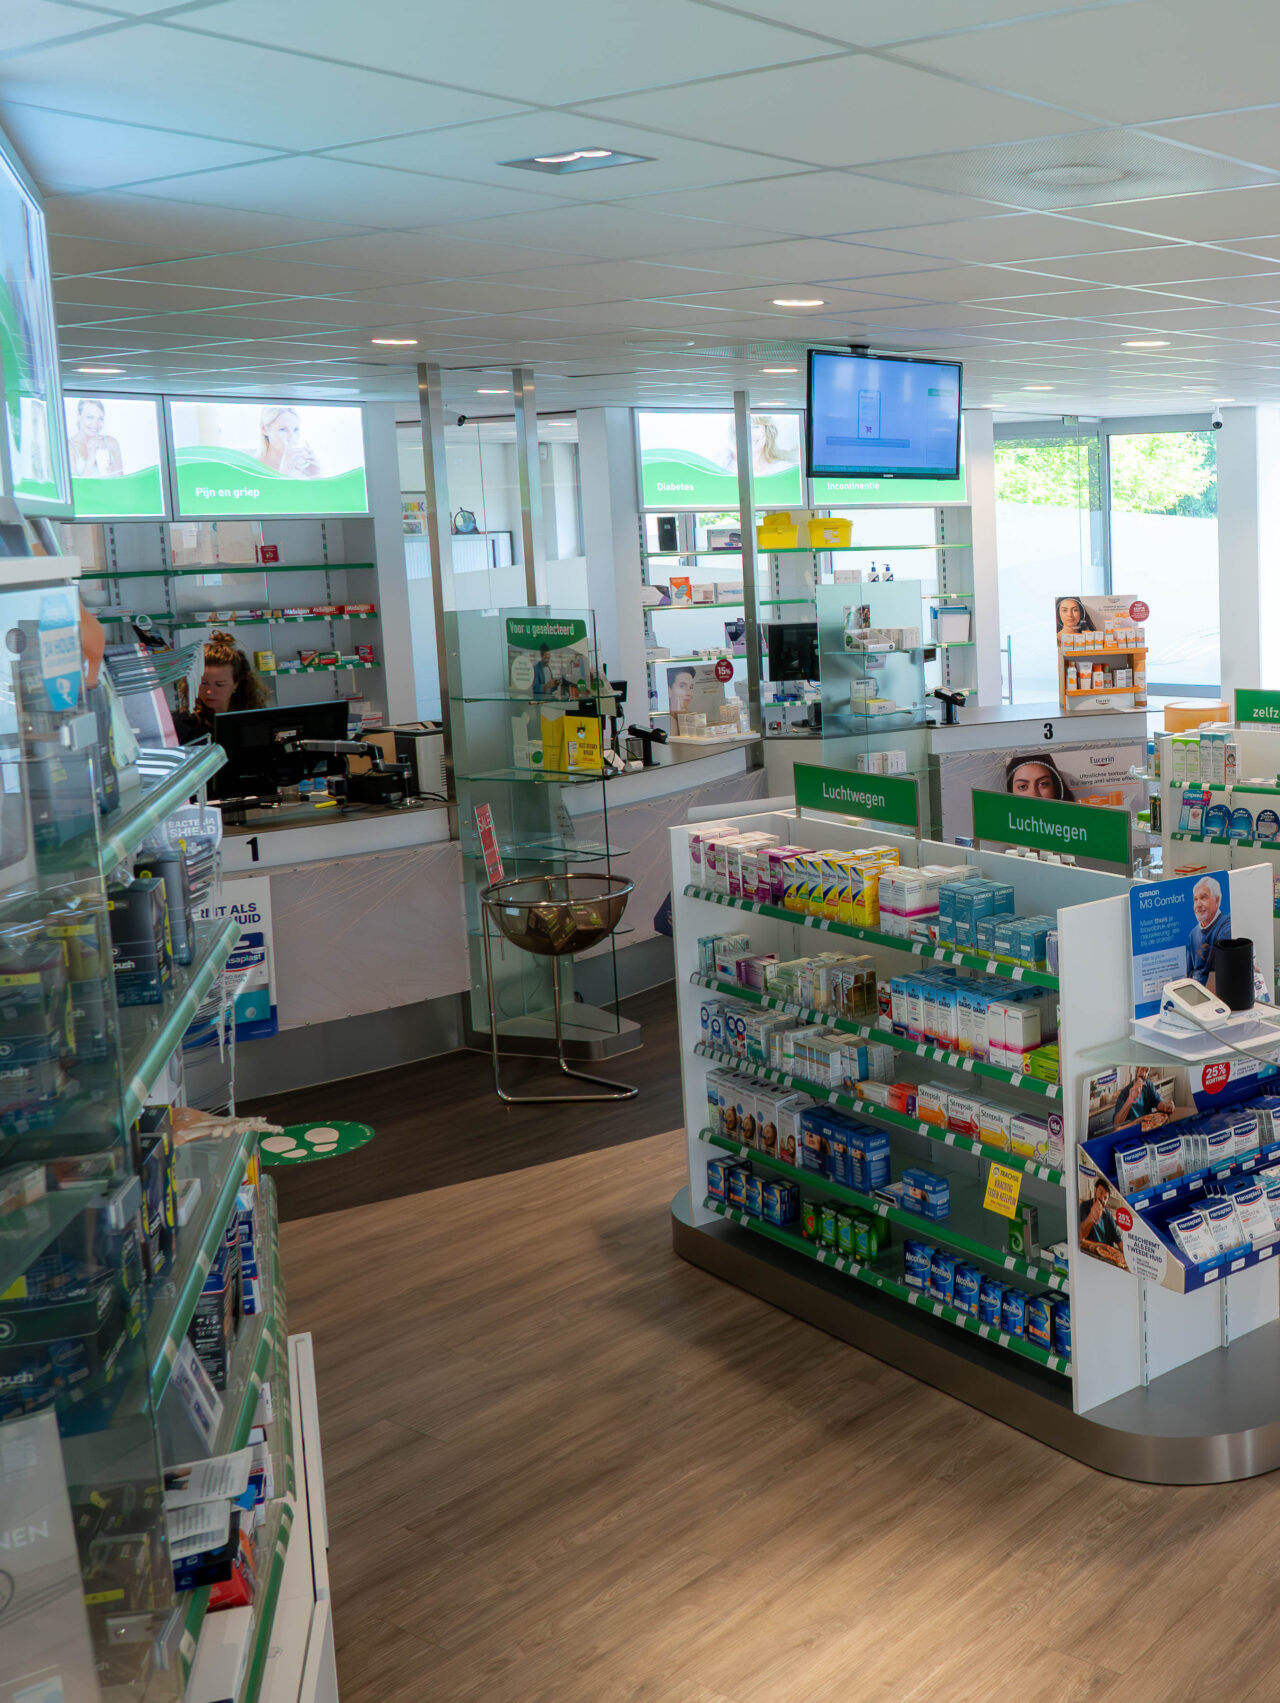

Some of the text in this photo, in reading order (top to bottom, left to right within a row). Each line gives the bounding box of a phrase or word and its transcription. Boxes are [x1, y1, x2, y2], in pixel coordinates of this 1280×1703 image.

[656, 482, 695, 492] Diabetes
[827, 481, 880, 490] Incontinentie
[195, 487, 260, 499] Pijn en griep
[509, 621, 575, 637] Voor u geselecteerd
[1043, 722, 1054, 740] 3
[1089, 755, 1115, 764] Eucerin
[822, 782, 886, 808] Luchtwegen
[168, 825, 217, 838] SHIELD
[1008, 812, 1088, 842] Luchtwegen
[245, 836, 260, 862] 1
[1138, 889, 1160, 898] omron
[231, 902, 257, 915] ALS
[1139, 894, 1185, 910] M3 Comfort
[939, 1000, 951, 1009] DARO
[958, 1000, 972, 1010] DARO
[973, 1006, 986, 1015] DARO
[1205, 1063, 1227, 1079] 25%
[1205, 1075, 1227, 1086] KORTING
[919, 1088, 941, 1102] Strepsils
[949, 1099, 973, 1113] Strepsils
[981, 1109, 1004, 1124] Strepsils
[1124, 1150, 1147, 1161] Hansaplast
[1236, 1189, 1263, 1203] Hansaplast
[1209, 1206, 1233, 1219] Hansaplast
[1178, 1216, 1204, 1231] Hansaplast
[1127, 1232, 1161, 1250] BESCHERMT
[1133, 1241, 1155, 1254] ALS EEN
[1127, 1244, 1149, 1259] TWEEDE
[1149, 1254, 1163, 1263] HUID
